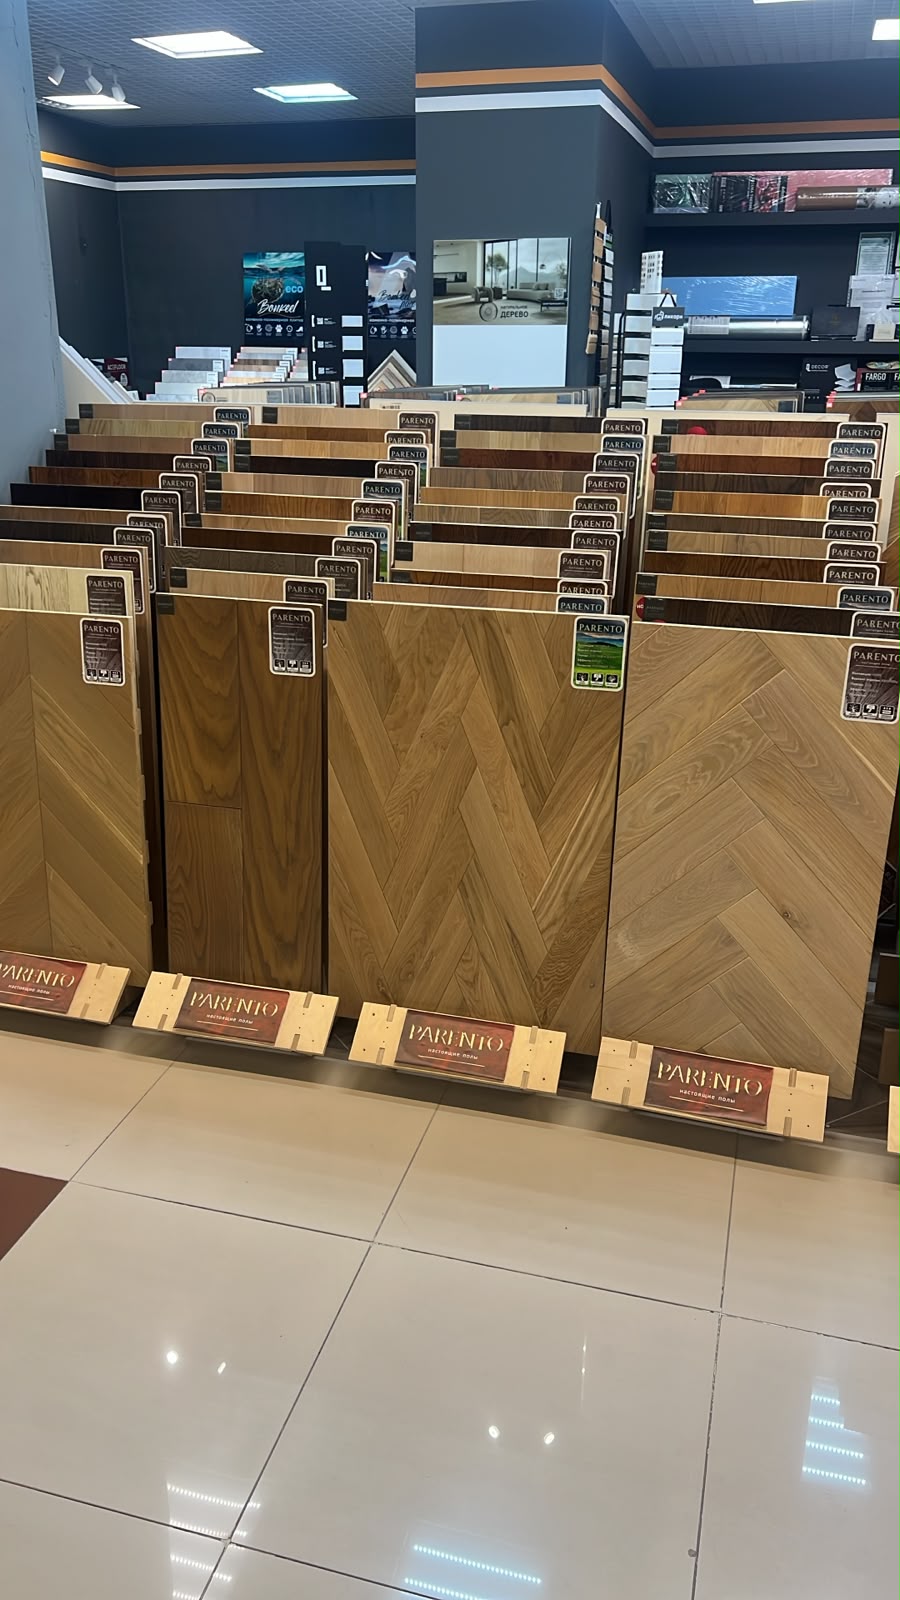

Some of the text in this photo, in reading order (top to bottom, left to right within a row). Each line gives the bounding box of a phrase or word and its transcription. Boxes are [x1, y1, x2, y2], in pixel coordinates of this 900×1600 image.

[865, 373, 886, 381] FARGO
[379, 468, 414, 476] PARENTO
[829, 465, 870, 473] PARENTO
[162, 480, 194, 488] PARENTO
[588, 480, 625, 488] PARENTO
[356, 507, 391, 515] PARENTO
[831, 505, 874, 513] PARENTO
[130, 521, 163, 529] PARENTO
[573, 520, 612, 528] PARENTO
[118, 534, 150, 542] PARENTO
[827, 529, 870, 539] PARENTO
[576, 537, 615, 546] PARENTO
[336, 545, 372, 553] PARENTO
[831, 548, 875, 558] PARENTO
[104, 555, 138, 563] PARENTO
[562, 558, 602, 567] PARENTO
[319, 564, 356, 573] PARENTO
[829, 570, 874, 580] PARENTO
[89, 580, 123, 588] PARENTO
[288, 585, 325, 594] PARENTO
[562, 586, 602, 595] PARENTO
[842, 594, 888, 604] PARENTO
[560, 602, 602, 611] PARENTO
[272, 613, 310, 622] PARENTO
[84, 624, 120, 634] PARENTO
[579, 624, 623, 633] PARENTO
[0, 963, 75, 988] PARENTO
[190, 992, 278, 1016] PARENTO
[206, 1014, 236, 1022] настоящие
[409, 1024, 503, 1051] PARENTO
[428, 1048, 460, 1057] настоящие
[658, 1062, 762, 1096] PARENTO
[680, 1089, 715, 1100] настоящие
